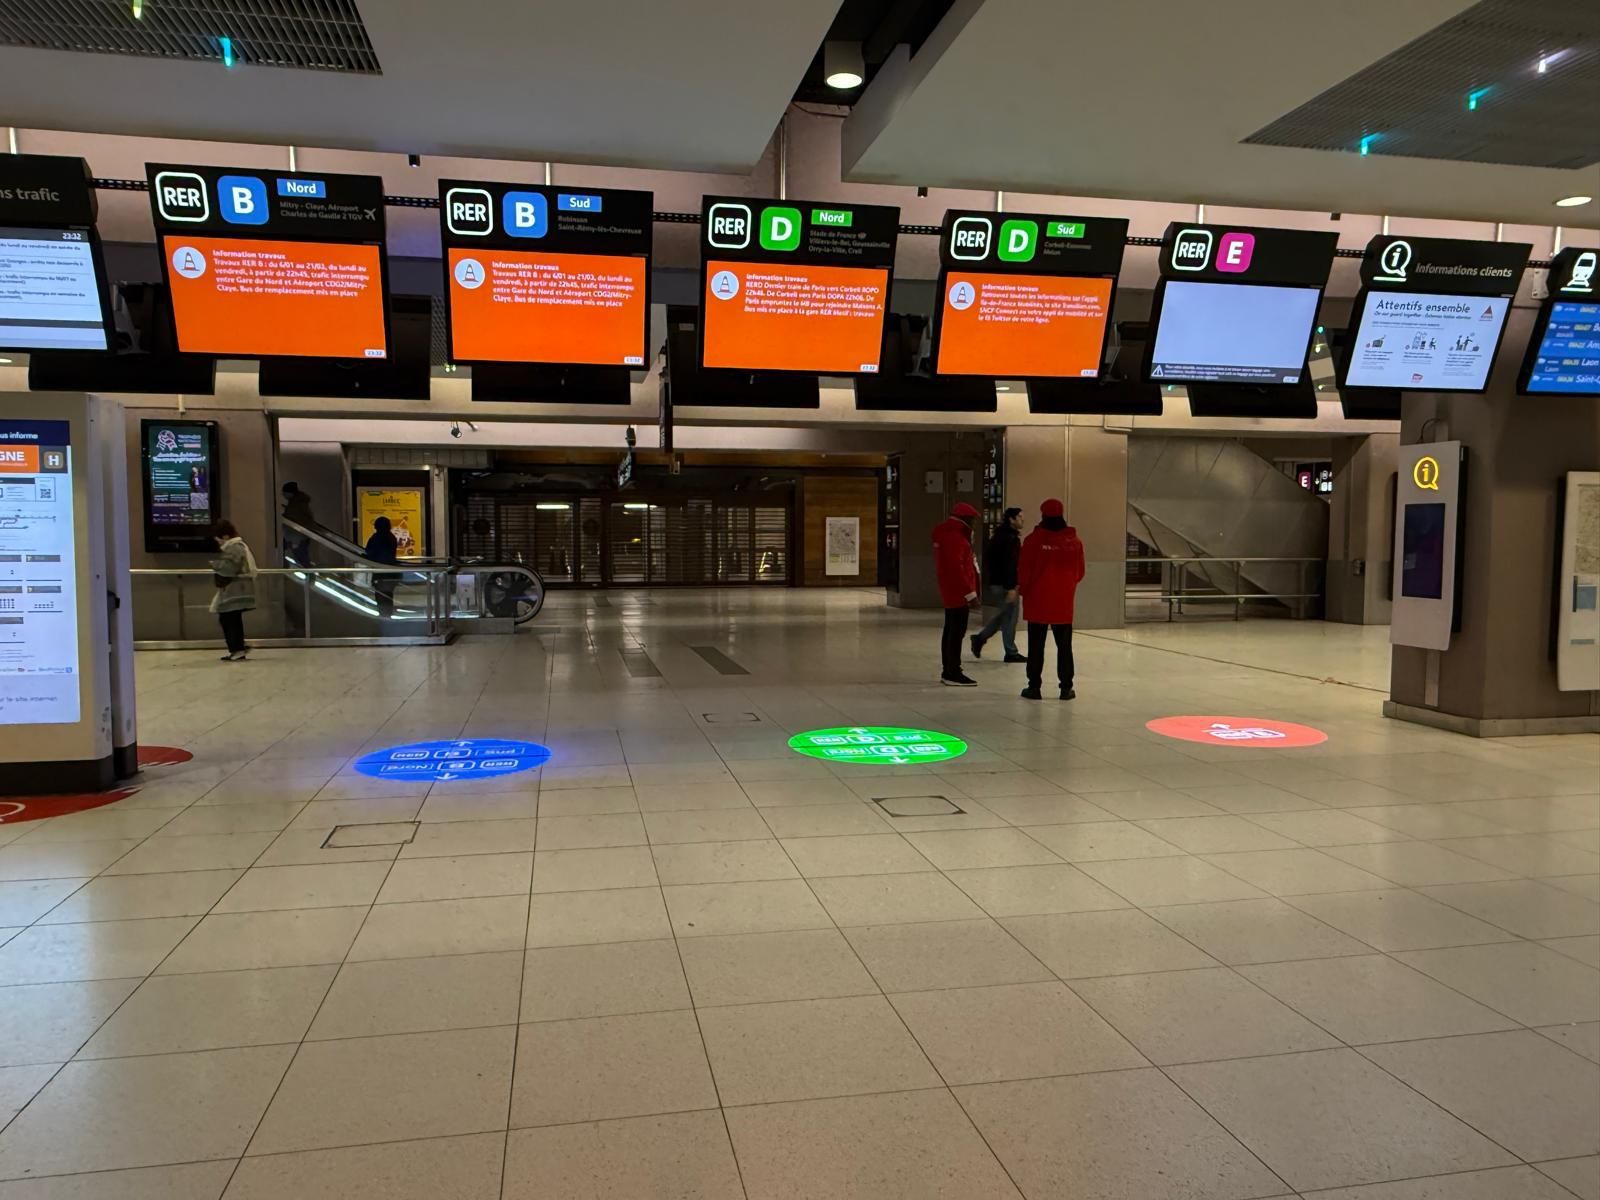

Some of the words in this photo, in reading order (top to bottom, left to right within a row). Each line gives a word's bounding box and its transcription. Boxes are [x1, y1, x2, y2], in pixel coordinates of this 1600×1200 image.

[16, 188, 60, 201] trafic
[287, 182, 317, 194] Nord
[164, 187, 201, 207] RER
[232, 187, 254, 214] B
[570, 198, 590, 208] Sud
[453, 203, 486, 222] RER
[515, 202, 535, 227] B
[820, 212, 844, 223] Nord
[714, 217, 745, 235] RER
[771, 217, 793, 241] D
[1057, 225, 1075, 235] Sud
[957, 230, 986, 248] RER
[1008, 229, 1028, 253] D
[213, 250, 256, 258] Information
[1178, 242, 1205, 259] RER
[1226, 241, 1244, 264] E
[492, 261, 532, 270] Information
[1416, 262, 1478, 276] Informations
[1479, 267, 1512, 277] clients
[265, 287, 314, 295] remplacement
[1376, 300, 1422, 311] Attentifs
[1426, 303, 1470, 313] ensemble
[1582, 358, 1599, 366] Laon
[48, 455, 59, 466] H
[1302, 476, 1308, 487] E
